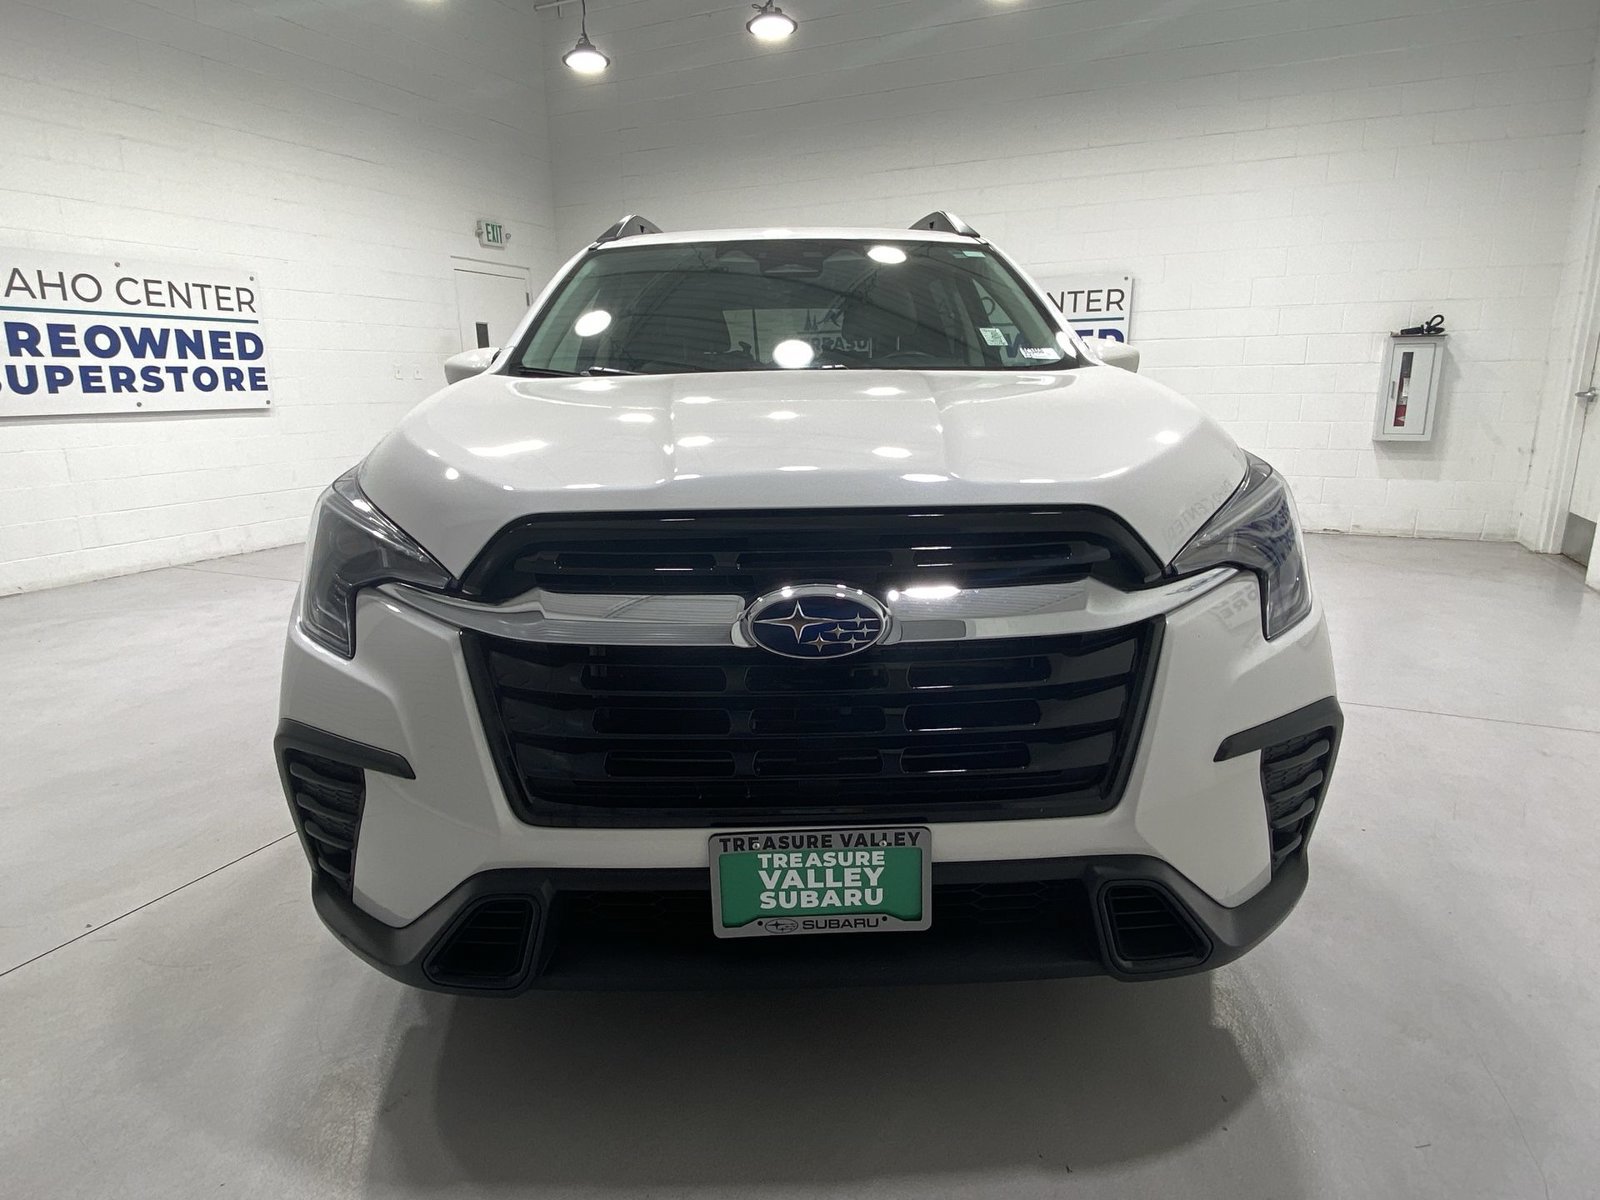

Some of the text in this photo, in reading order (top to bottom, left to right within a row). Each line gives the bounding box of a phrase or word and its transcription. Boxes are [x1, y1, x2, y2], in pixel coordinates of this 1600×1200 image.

[485, 223, 502, 244] EXIT
[115, 277, 256, 313] CENTER
[3, 321, 264, 361] REOWNED
[0, 364, 269, 395] UPERSTORE
[719, 831, 920, 852] TREASURE VALLEY
[757, 851, 885, 868] TREASURE
[758, 867, 885, 889] VALLEY
[759, 888, 884, 909] SUBARU
[802, 918, 879, 930] SUBARU
